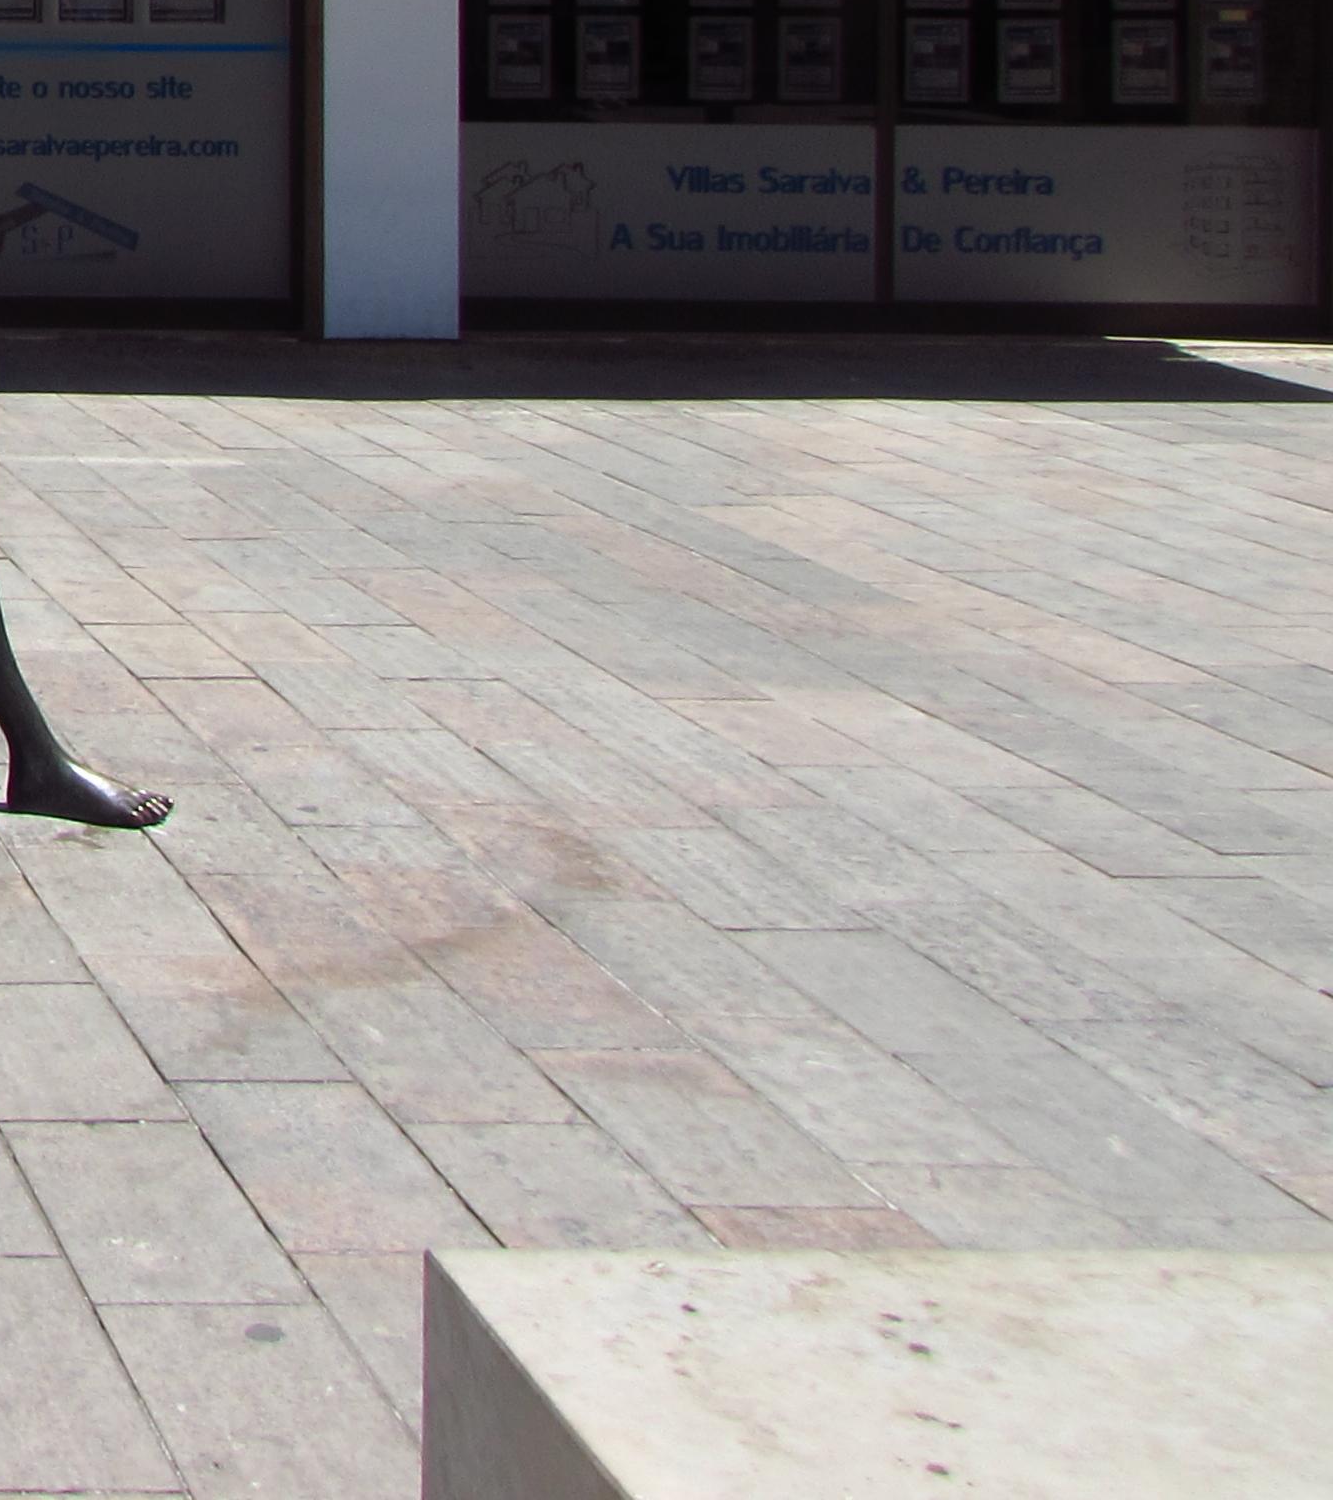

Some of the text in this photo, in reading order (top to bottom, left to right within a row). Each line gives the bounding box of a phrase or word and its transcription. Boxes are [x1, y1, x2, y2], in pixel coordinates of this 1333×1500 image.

[32, 80, 48, 99] o
[58, 80, 136, 100] nosso
[146, 75, 194, 100] site
[666, 165, 1055, 195] Villas Saraiva & Pereira
[609, 222, 1103, 260] A Sua Imobiliária De Confiança
